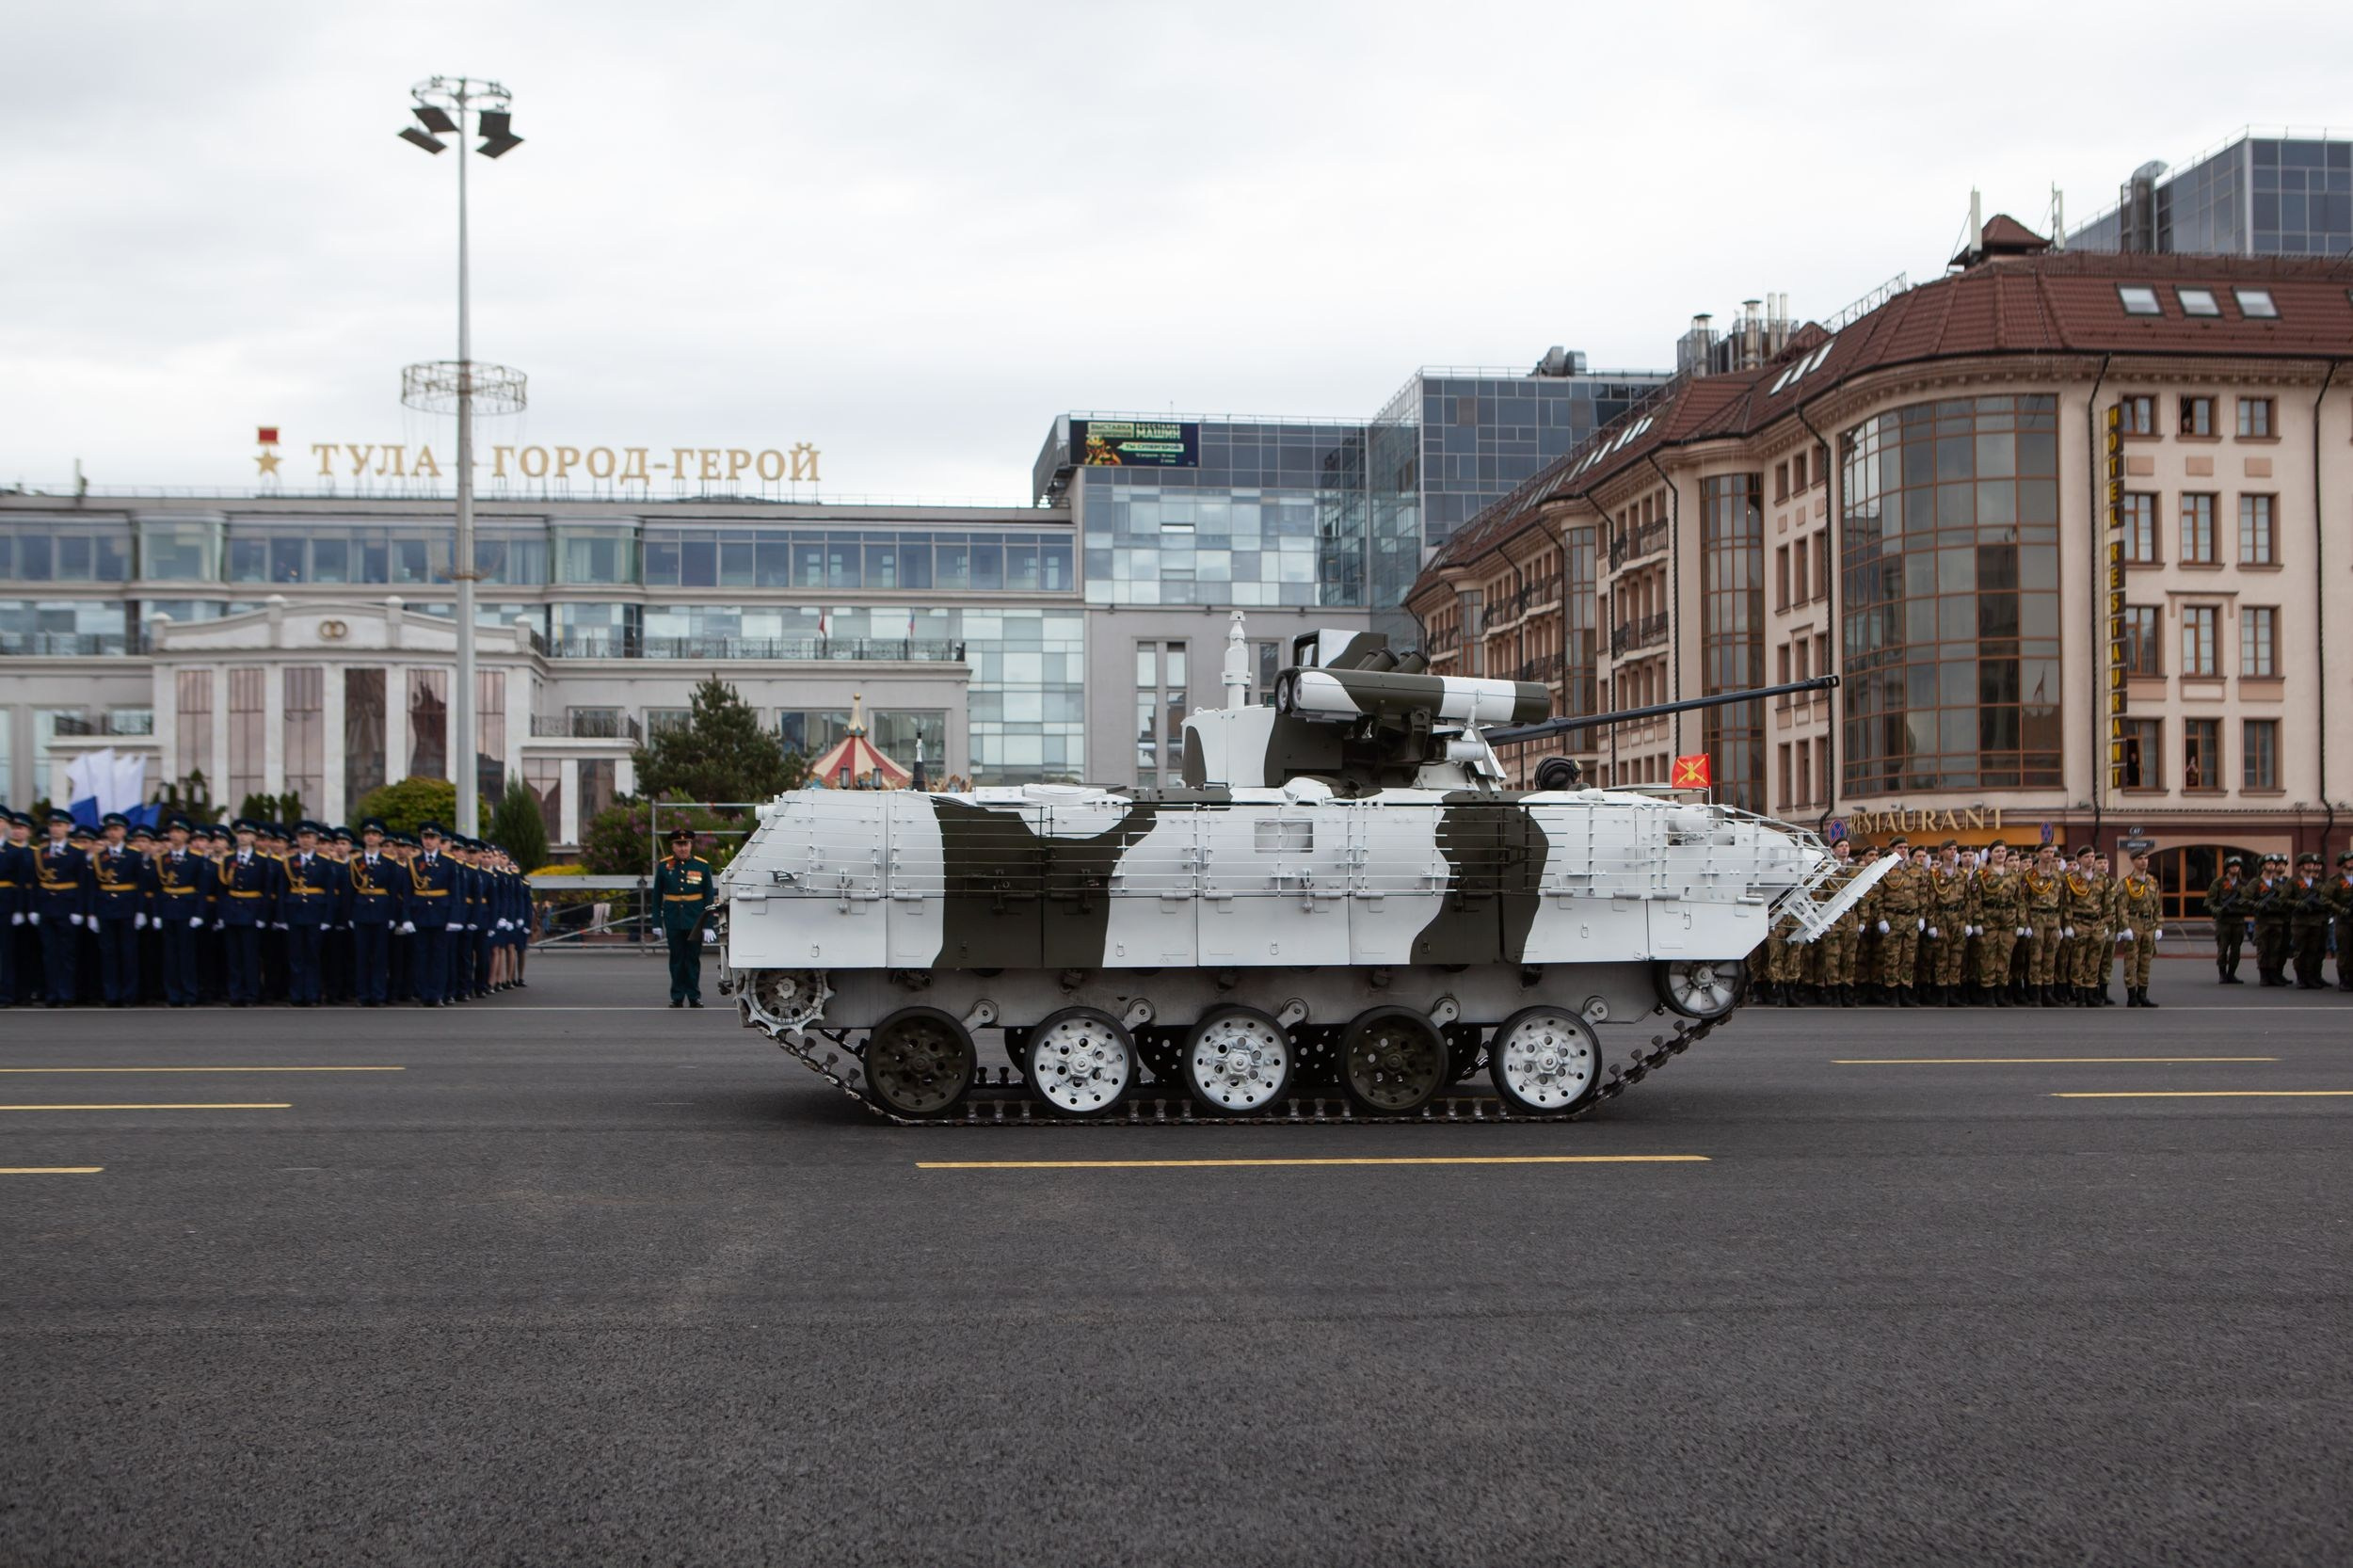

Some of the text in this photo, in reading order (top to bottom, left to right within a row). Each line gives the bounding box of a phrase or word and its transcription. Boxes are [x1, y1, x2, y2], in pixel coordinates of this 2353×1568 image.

[1136, 428, 1180, 439] МАШИН
[312, 442, 822, 486] ТУЛА ГОРОД-ГЕРОЙ
[2109, 406, 2121, 786] HOTEL RESTAURANT
[1849, 808, 2002, 835] RESTAURANT
